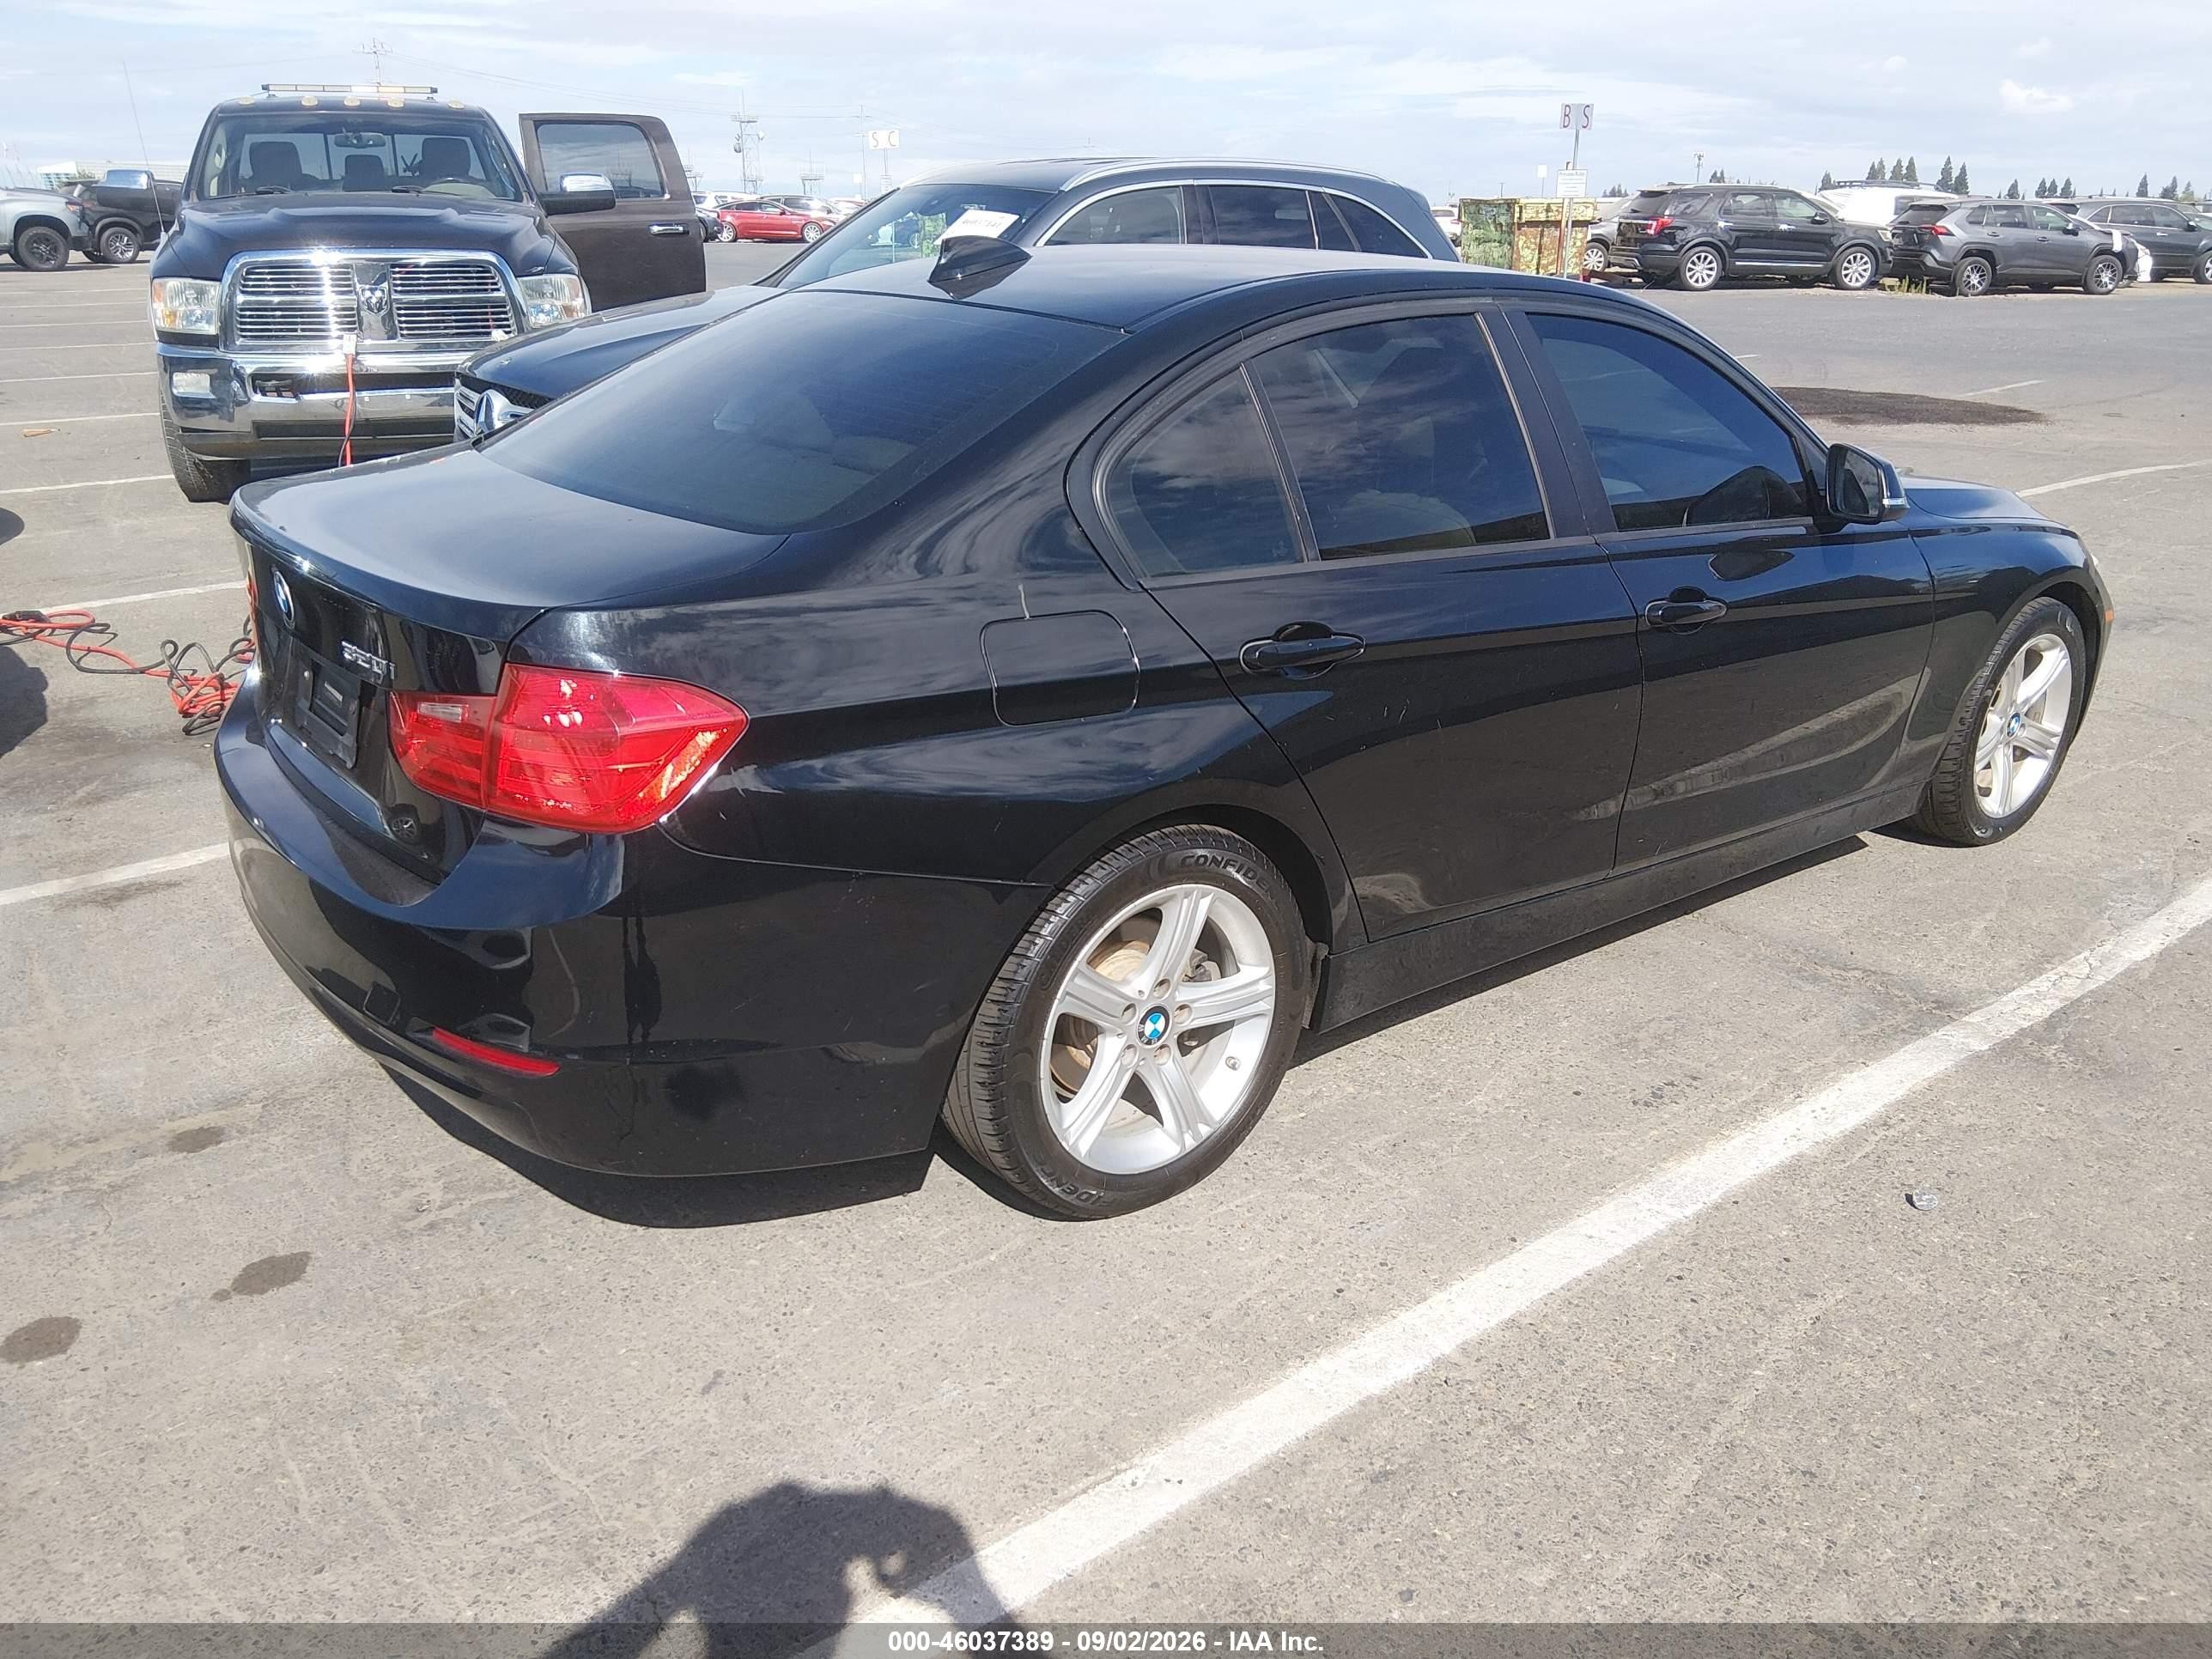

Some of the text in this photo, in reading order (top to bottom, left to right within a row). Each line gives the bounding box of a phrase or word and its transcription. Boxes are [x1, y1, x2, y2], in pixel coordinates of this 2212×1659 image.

[1563, 105, 1590, 129] B S
[872, 131, 896, 148] S C
